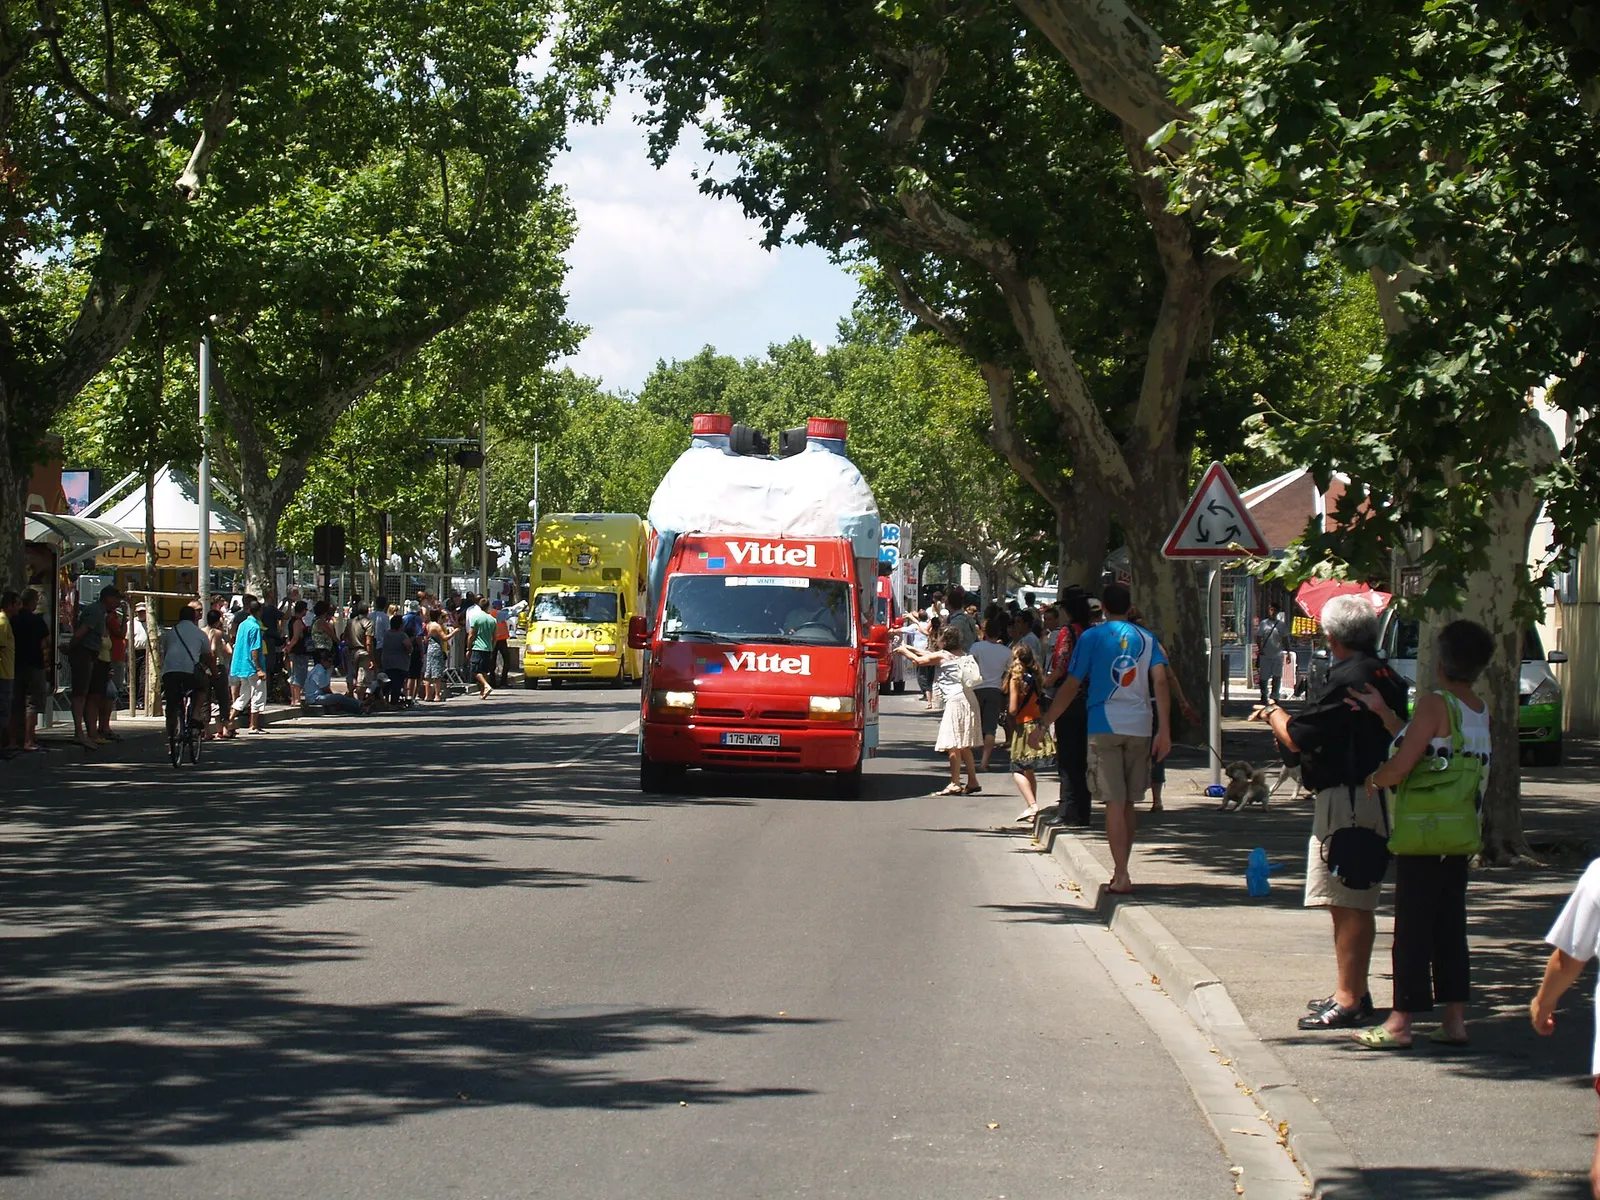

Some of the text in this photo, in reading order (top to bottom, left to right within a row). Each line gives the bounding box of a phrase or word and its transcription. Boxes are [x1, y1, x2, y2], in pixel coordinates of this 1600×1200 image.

[725, 541, 817, 567] Vittel
[723, 651, 811, 676] Vittel
[729, 734, 745, 744] 175
[768, 735, 779, 745] 75
